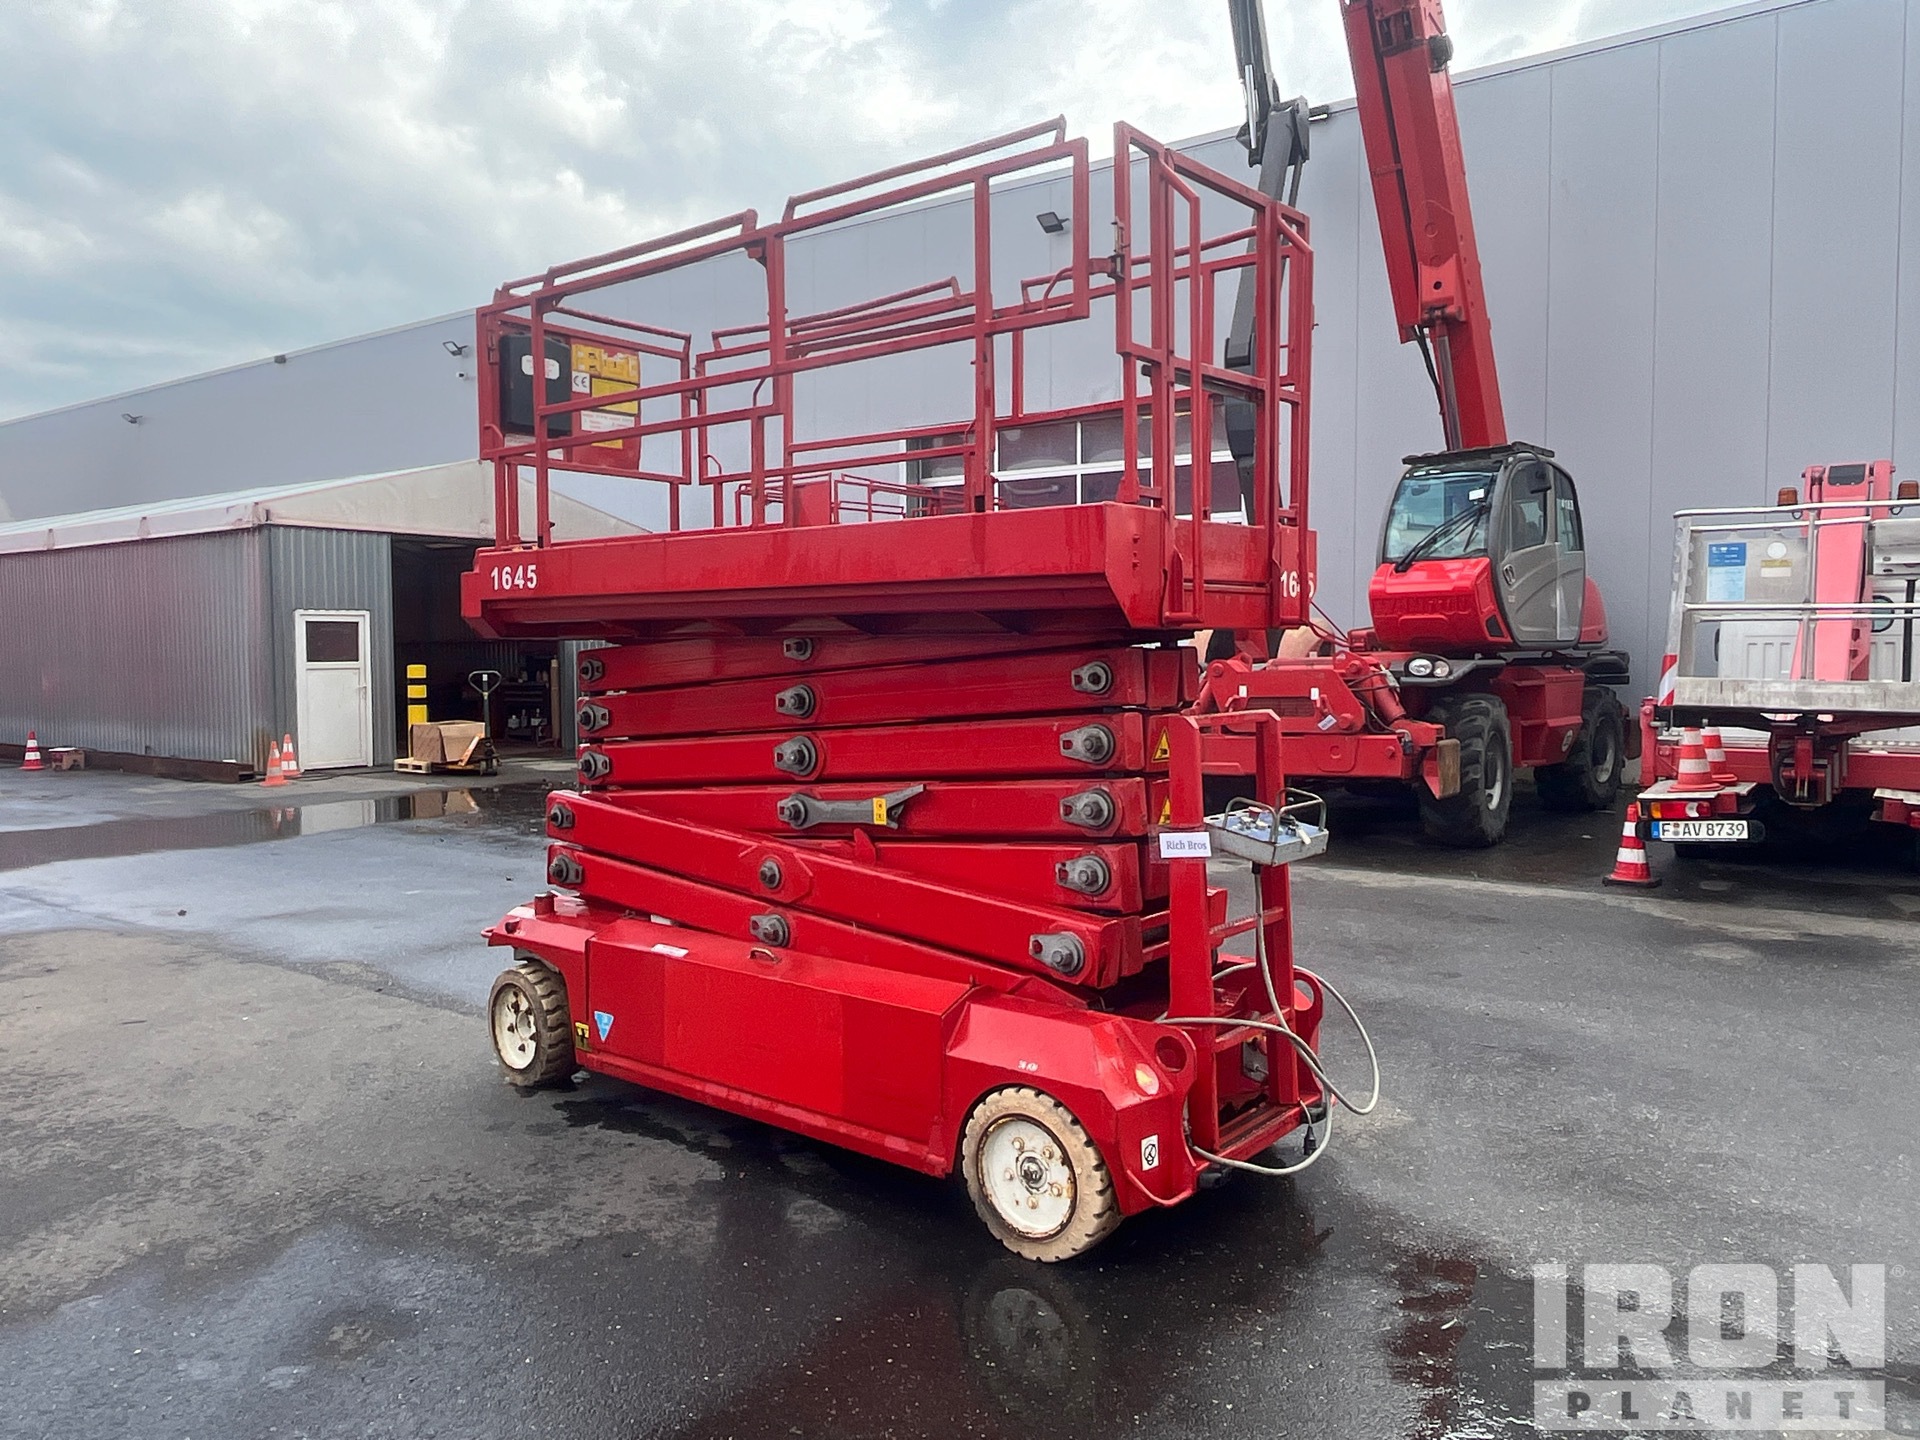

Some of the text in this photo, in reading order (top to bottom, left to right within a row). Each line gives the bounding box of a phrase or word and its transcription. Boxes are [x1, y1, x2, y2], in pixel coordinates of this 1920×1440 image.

[490, 564, 537, 591] 1645
[1280, 571, 1315, 598] 165
[1661, 822, 1745, 837] F AV 8739
[1166, 840, 1207, 850] Rich Bros
